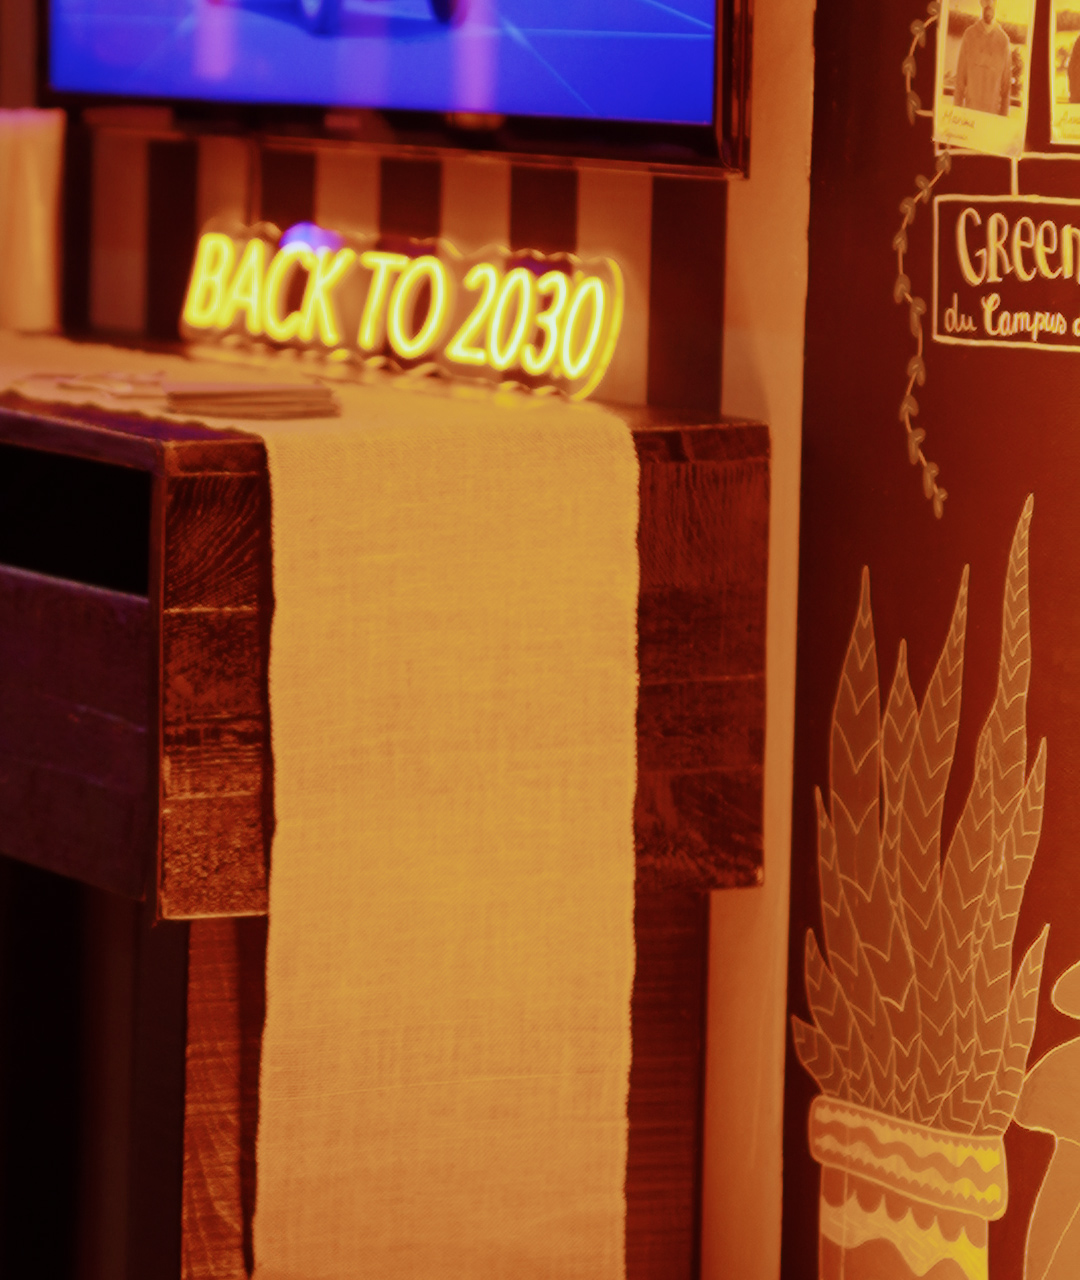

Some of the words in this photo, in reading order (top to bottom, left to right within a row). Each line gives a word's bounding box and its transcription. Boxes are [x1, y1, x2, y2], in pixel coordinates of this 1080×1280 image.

[182, 231, 357, 347] BACK
[358, 249, 449, 359] TO
[445, 261, 606, 381] 2030
[944, 292, 978, 333] du
[980, 292, 1068, 342] Campus
